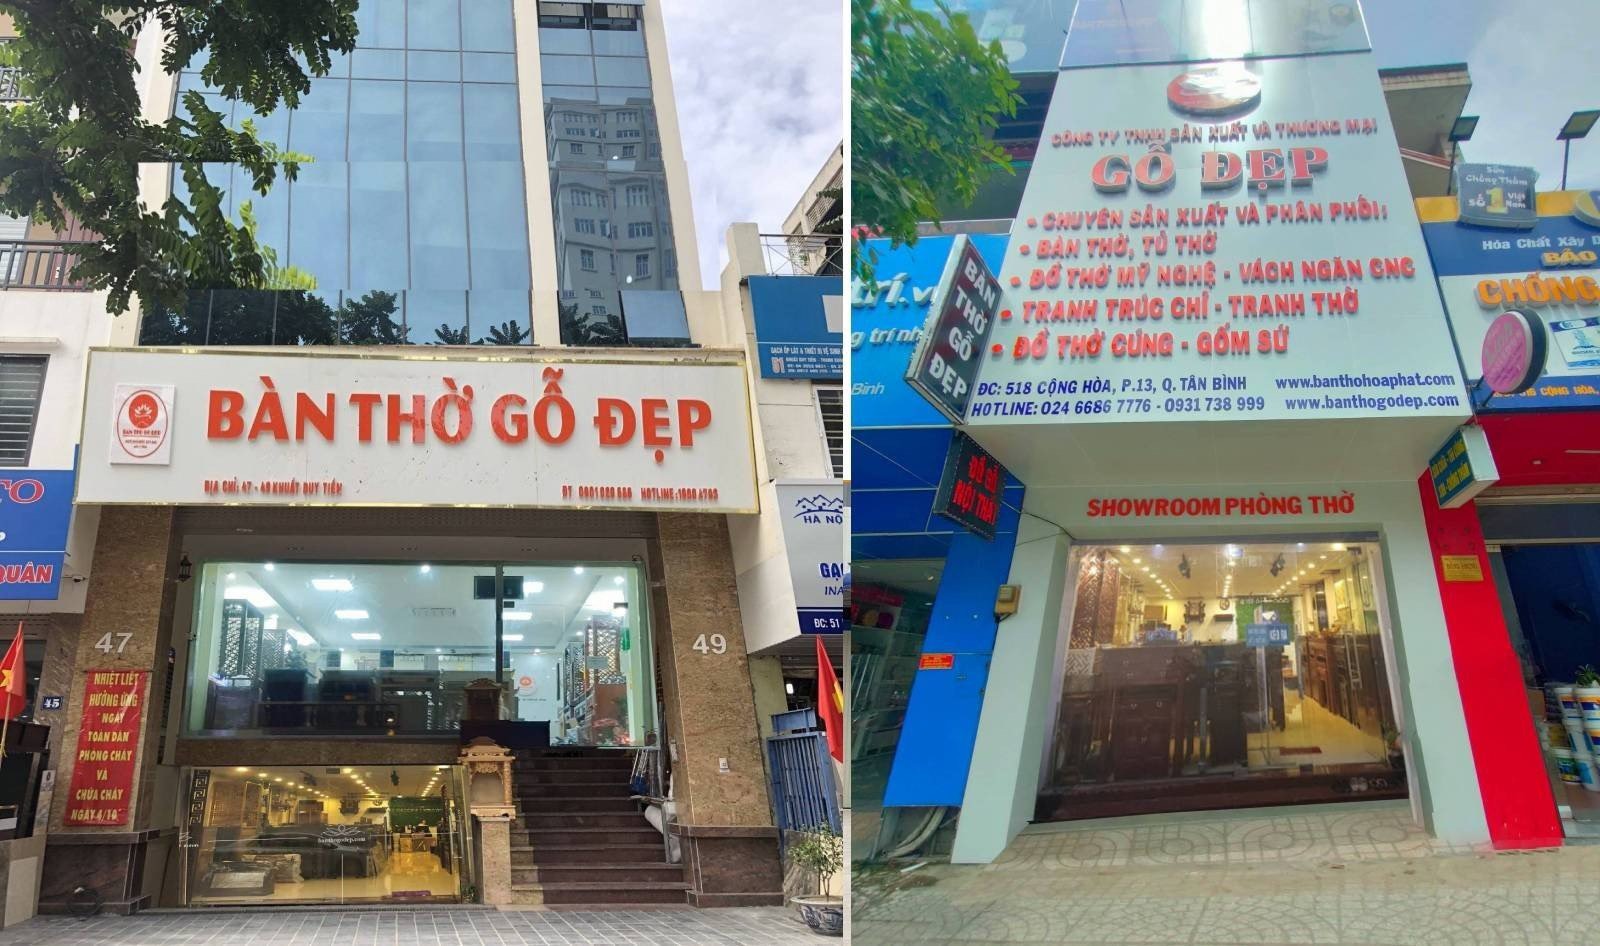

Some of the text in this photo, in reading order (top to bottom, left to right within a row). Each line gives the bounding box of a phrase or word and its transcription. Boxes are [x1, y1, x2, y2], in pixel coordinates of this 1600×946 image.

[1052, 130, 1093, 147] CÔNG
[1098, 130, 1120, 145] TY
[1170, 123, 1202, 144] SẢN
[1209, 121, 1248, 142] XUẤT
[1253, 121, 1271, 140] VÀ
[1275, 119, 1341, 139] THƯƠNG
[1345, 118, 1378, 136] MẠI
[1090, 138, 1329, 197] GỖ ĐẸP
[1042, 208, 1123, 230] CHUYÊN
[1129, 203, 1169, 228] SẢN
[1176, 201, 1228, 226] XUẤT
[1235, 202, 1260, 225] VÀ
[1266, 200, 1323, 224] PHÂN
[1486, 187, 1508, 214] 1
[1036, 235, 1080, 260] BÀN
[1142, 230, 1168, 255] TỦ
[1175, 229, 1217, 256] THỜ
[1482, 239, 1511, 250] Hóa
[1516, 233, 1552, 248] Chất
[1557, 236, 1585, 247] Xây
[965, 257, 996, 310] BÀN
[1068, 262, 1112, 288] THỜ
[1117, 261, 1150, 288] MỸ
[1157, 260, 1216, 288] NGHỆ
[1239, 257, 1294, 284] VÁCH
[1302, 256, 1362, 281] NGĂN
[1369, 256, 1416, 279] CNC
[956, 285, 988, 335] THỜ
[1023, 300, 1098, 324] TRANH
[1106, 294, 1163, 321] TRÚC
[1228, 293, 1305, 319] TRANH
[1312, 286, 1358, 316] THỜ
[949, 326, 975, 362] GỖ
[1057, 328, 1105, 359] THỜ
[1197, 322, 1250, 356] GỐM
[1257, 323, 1290, 353] SỨ
[929, 351, 967, 398] ĐẸP
[977, 372, 1456, 397] ĐC: 518 CỘNG HÒA, P.13, Q. TÂN BÌNH www.banthohoaphat.com
[206, 366, 712, 464] BÀN THỜ GỖ ĐẸP
[971, 401, 1038, 416] HOTLINE:
[1041, 401, 1069, 415] 024
[1074, 400, 1111, 415] 6686
[1116, 399, 1151, 414] 7776
[1165, 398, 1201, 413] 0931
[1205, 397, 1232, 412] 738
[1237, 396, 1265, 411] 999
[1285, 395, 1460, 410] www.banthogodep.com
[1087, 490, 1356, 517] SHOWROOM PHÒNG THỜ
[819, 562, 843, 581] GẠ
[94, 631, 134, 653] 47
[691, 633, 727, 654] 49
[94, 671, 120, 688] NHIỆT
[43, 697, 60, 708] 45
[96, 767, 108, 781] VÀ
